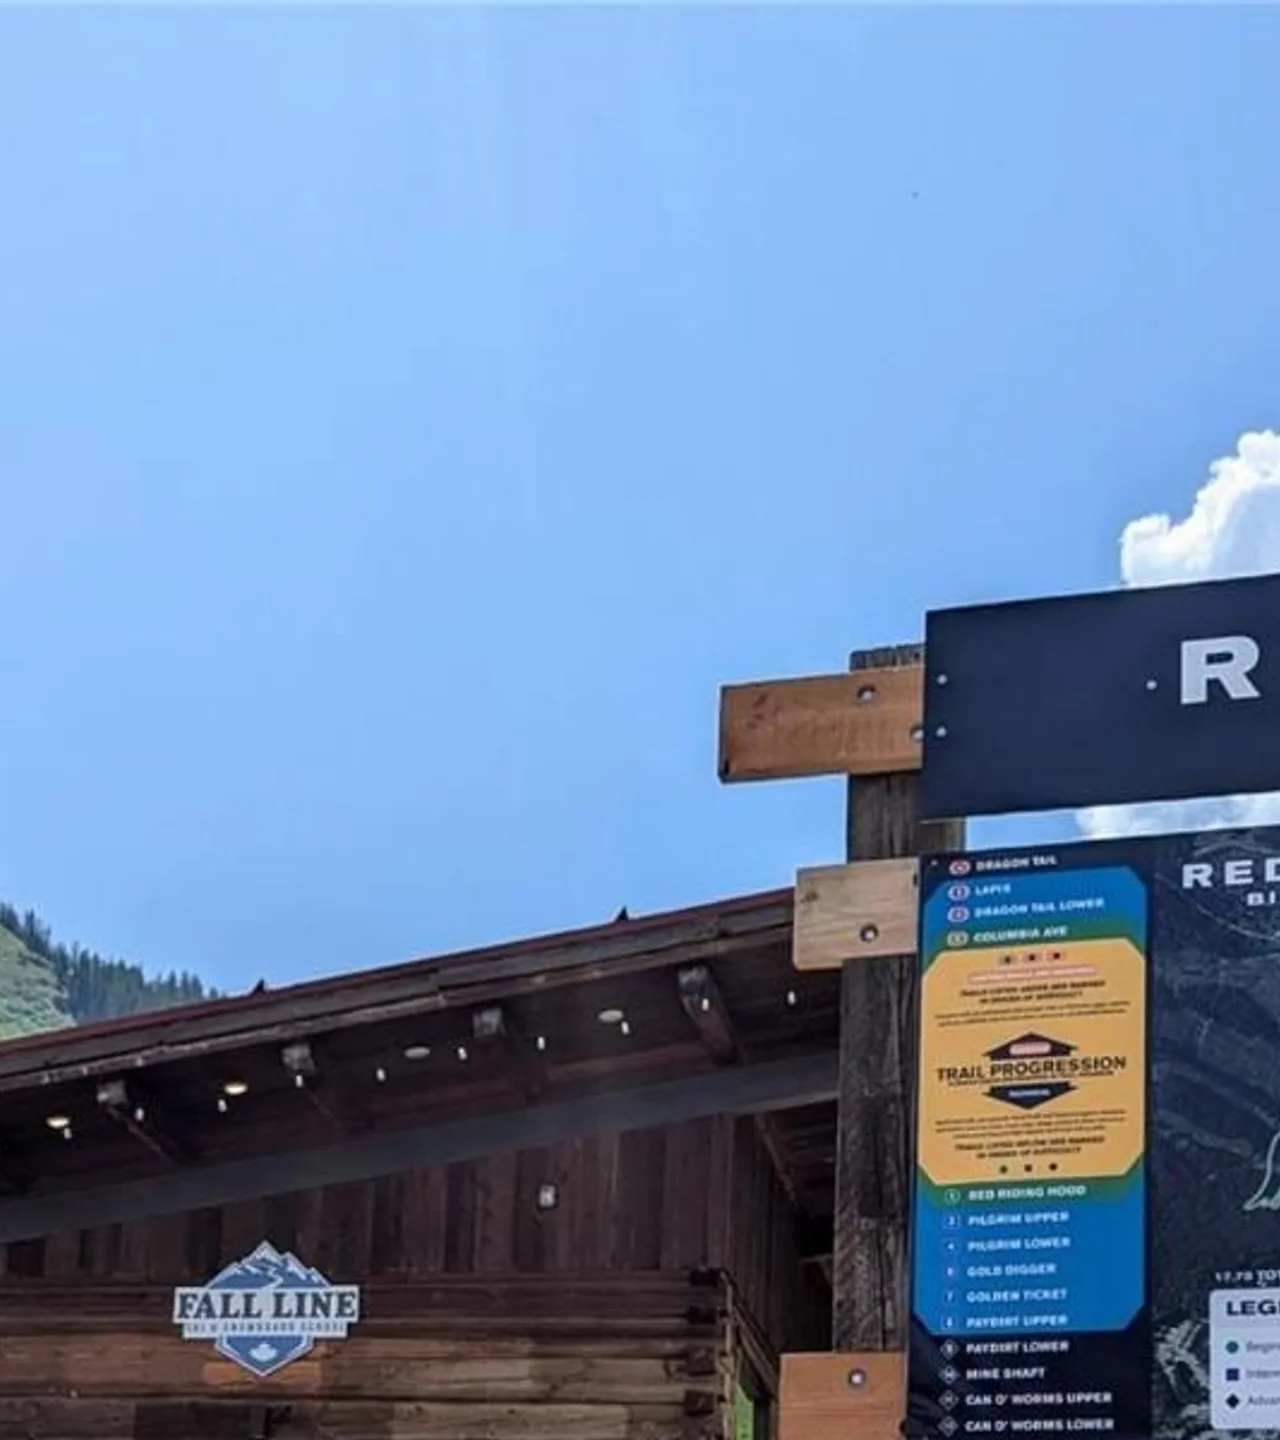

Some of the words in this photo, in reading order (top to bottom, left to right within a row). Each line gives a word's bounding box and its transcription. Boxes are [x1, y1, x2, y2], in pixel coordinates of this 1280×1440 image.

[975, 858, 1030, 872] DRAGON
[1033, 855, 1058, 867] TAIL
[974, 904, 1029, 919] DRAGON
[1032, 901, 1057, 913] TAIL
[1059, 898, 1106, 911] LOWER
[973, 928, 1041, 943] COLUMBIA
[1043, 926, 1068, 938] AVE
[937, 1066, 985, 1082] TRAIL
[990, 1056, 1127, 1080] PROGRESSION
[968, 1189, 994, 1201] RED
[997, 1187, 1045, 1200] RIDING
[1047, 1185, 1086, 1197] HOOD
[968, 1213, 1022, 1226] PILGRIM
[1024, 1211, 1069, 1224] UPPER
[967, 1239, 1021, 1252] PILGRIM
[1024, 1237, 1071, 1249] LOWER
[967, 1265, 1002, 1277] GOLD
[1005, 1263, 1057, 1275] DIGGER
[966, 1291, 1021, 1303] GOLDEN
[1023, 1289, 1068, 1301] TICKET
[177, 1292, 262, 1319] FALL
[273, 1291, 356, 1319] LINE
[966, 1316, 1021, 1329] PAYDIRT
[1024, 1314, 1068, 1327] UPPER
[966, 1342, 1021, 1354] PAYDIRT
[1023, 1340, 1070, 1353] LOWER
[966, 1368, 1000, 1380] MINE
[1002, 1367, 1046, 1380] SHAFT
[965, 1394, 992, 1405] CAN
[1011, 1393, 1064, 1405] WORMS
[1067, 1392, 1112, 1404] UPPER
[964, 1420, 991, 1432] CAN
[1011, 1419, 1064, 1431] WORMS
[1067, 1418, 1115, 1431] LOWER
